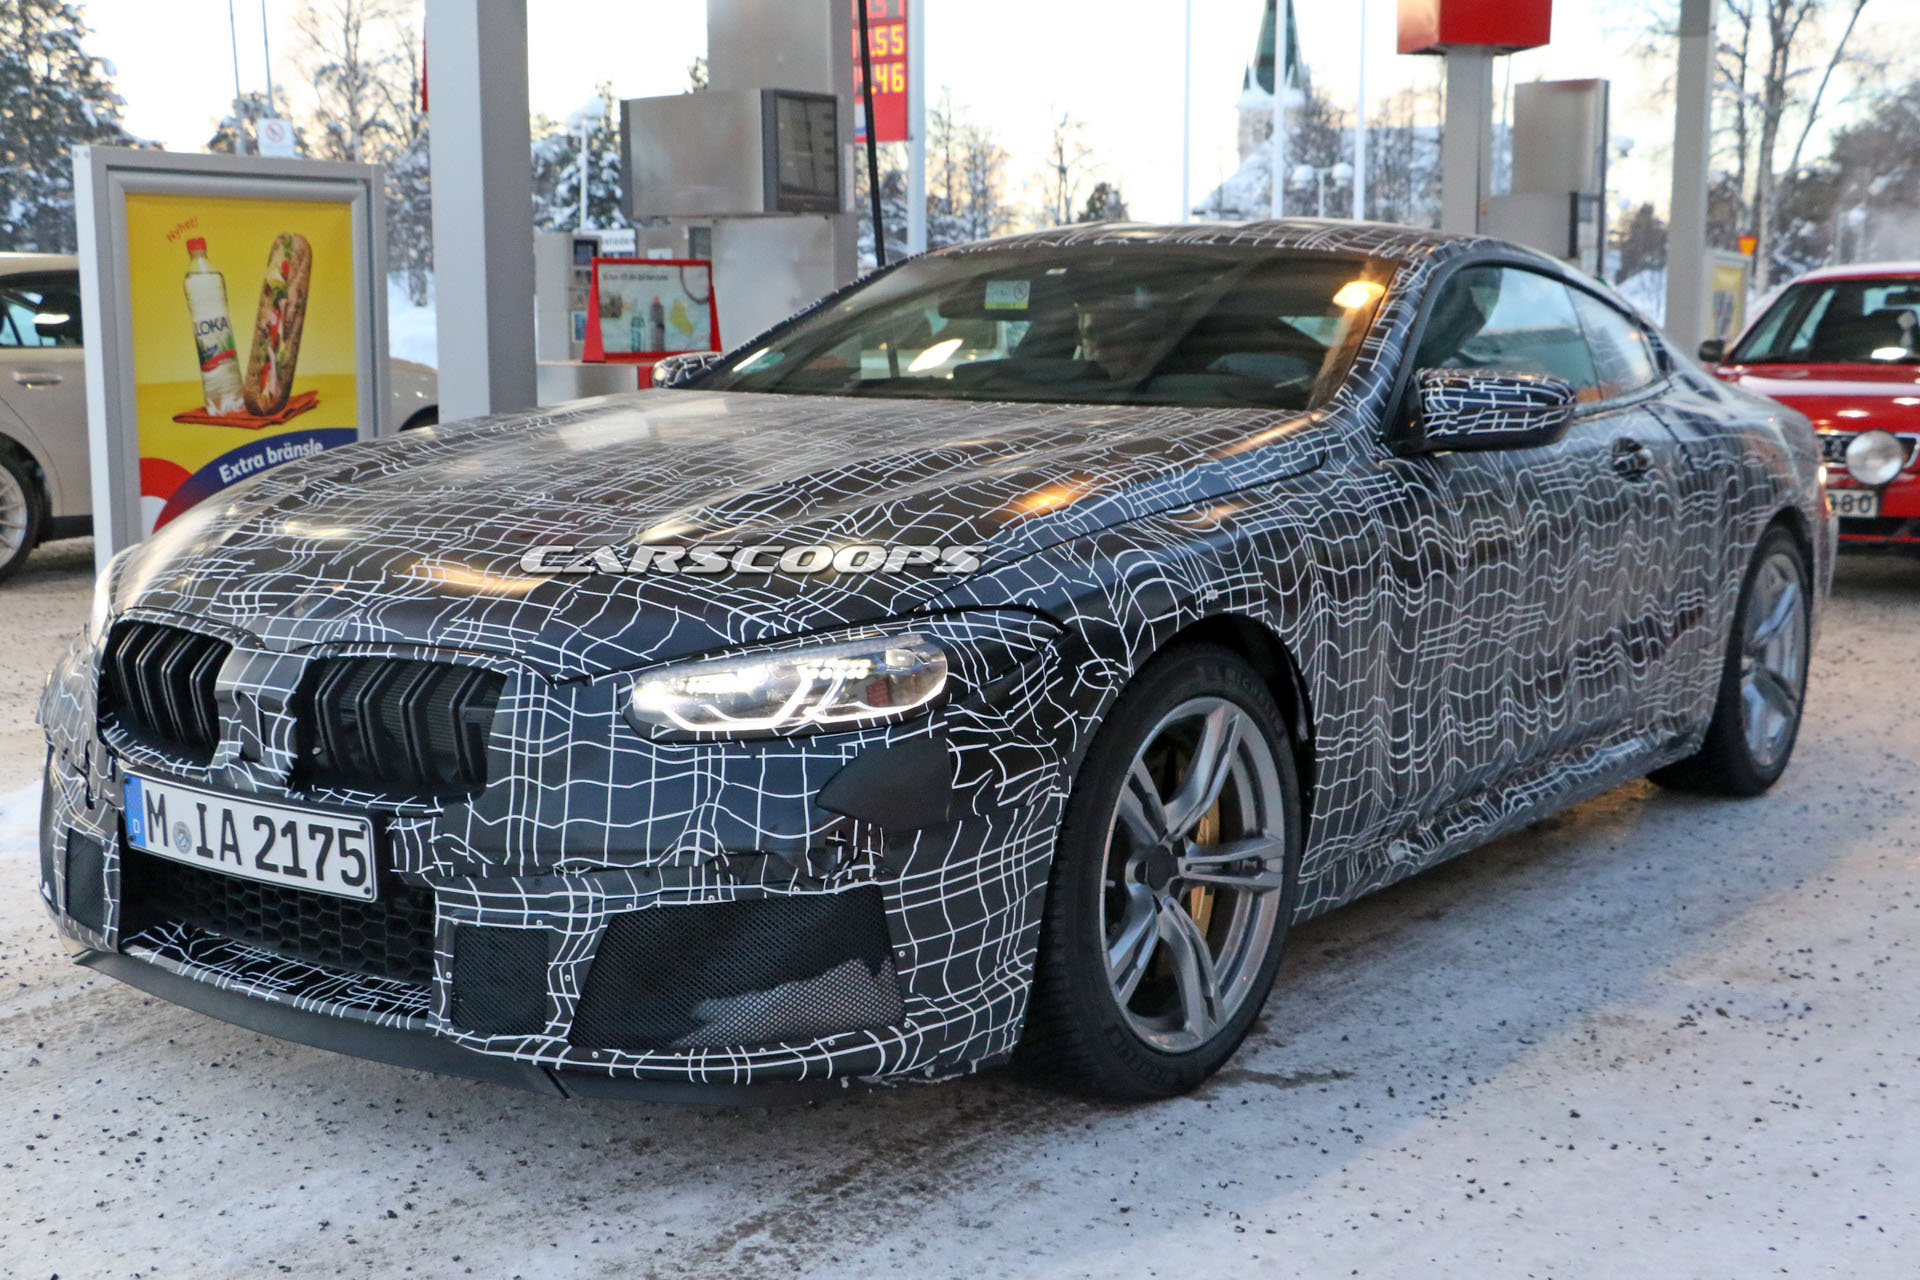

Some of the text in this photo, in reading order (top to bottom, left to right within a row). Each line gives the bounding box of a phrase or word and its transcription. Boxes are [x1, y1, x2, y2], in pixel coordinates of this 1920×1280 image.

[193, 316, 230, 337] LOKA
[219, 438, 324, 483] Extra bränsle
[132, 818, 141, 834] D
